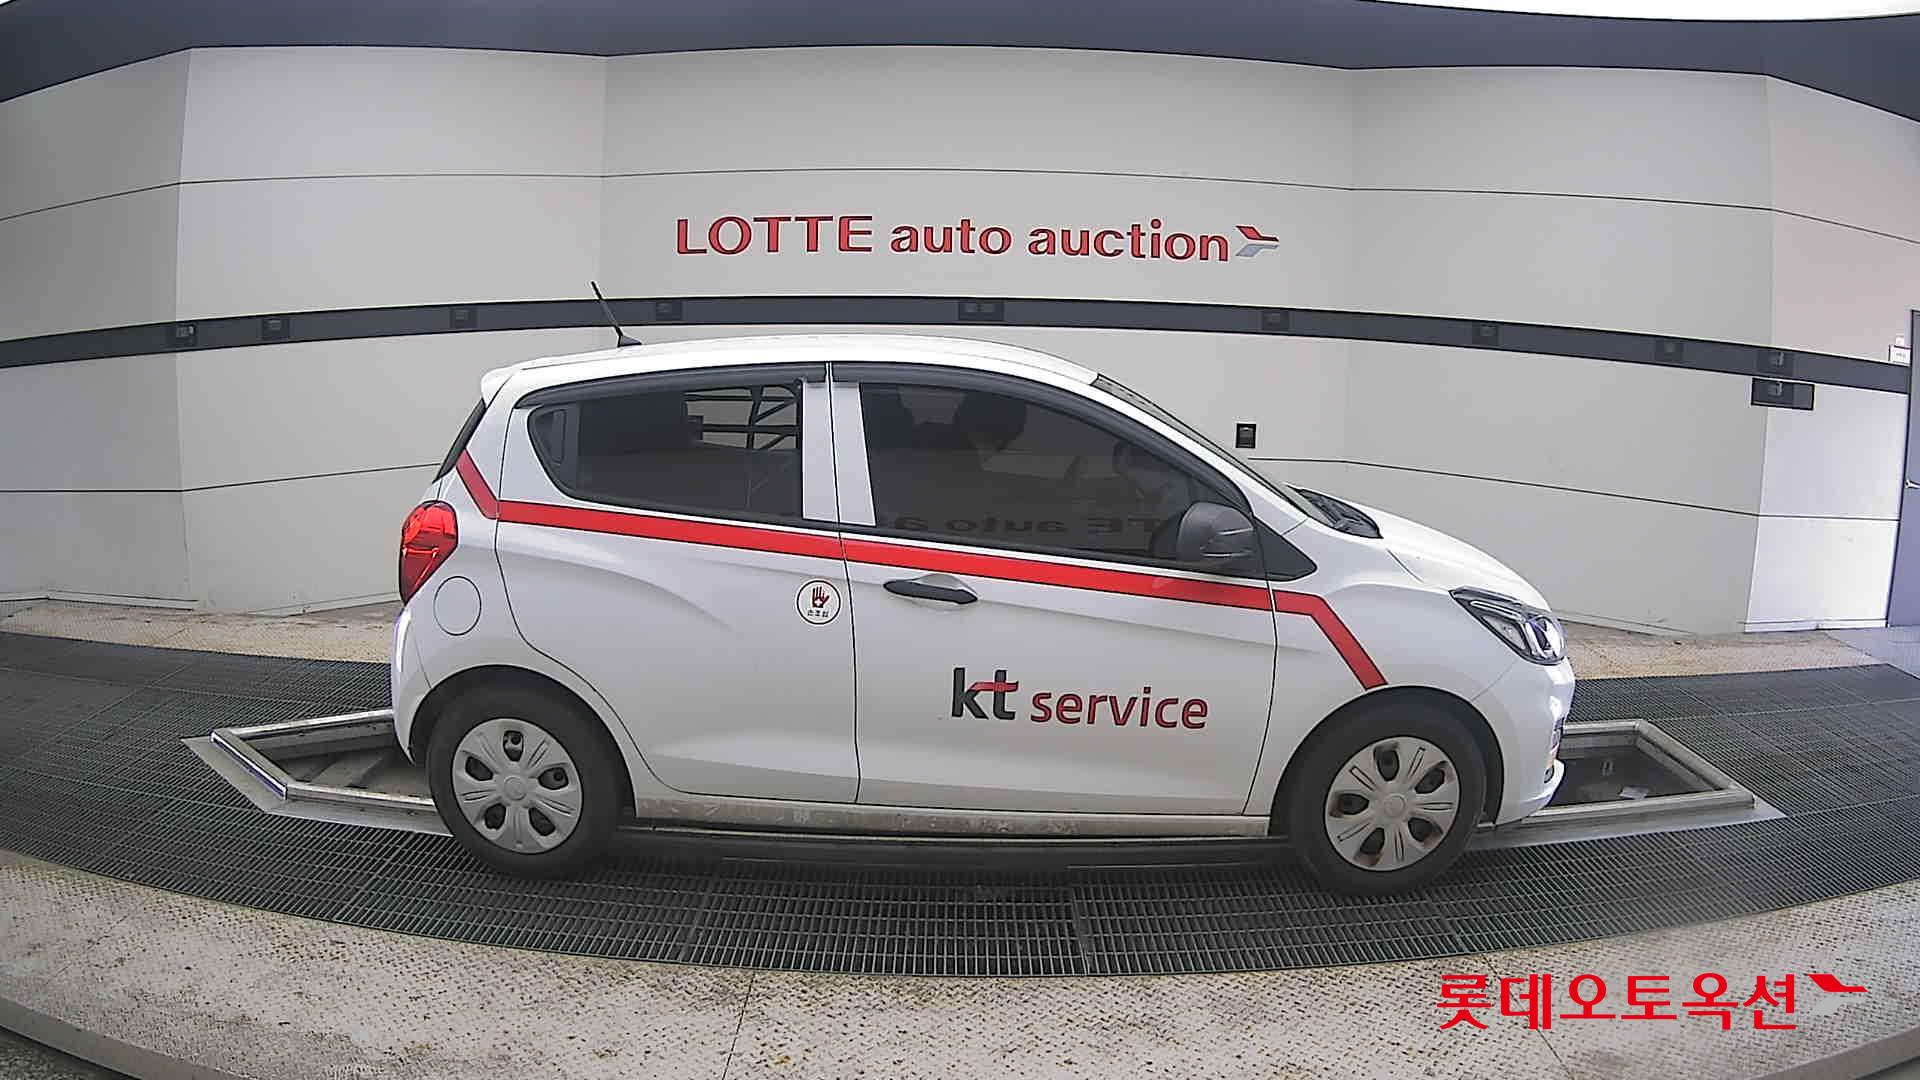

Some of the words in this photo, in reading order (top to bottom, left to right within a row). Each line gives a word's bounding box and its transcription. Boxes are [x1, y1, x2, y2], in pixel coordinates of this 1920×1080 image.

[677, 216, 873, 255] LOTTE
[891, 219, 1013, 254] auto
[1028, 219, 1229, 262] auction
[951, 667, 1019, 721] kt
[1030, 686, 1208, 729] service
